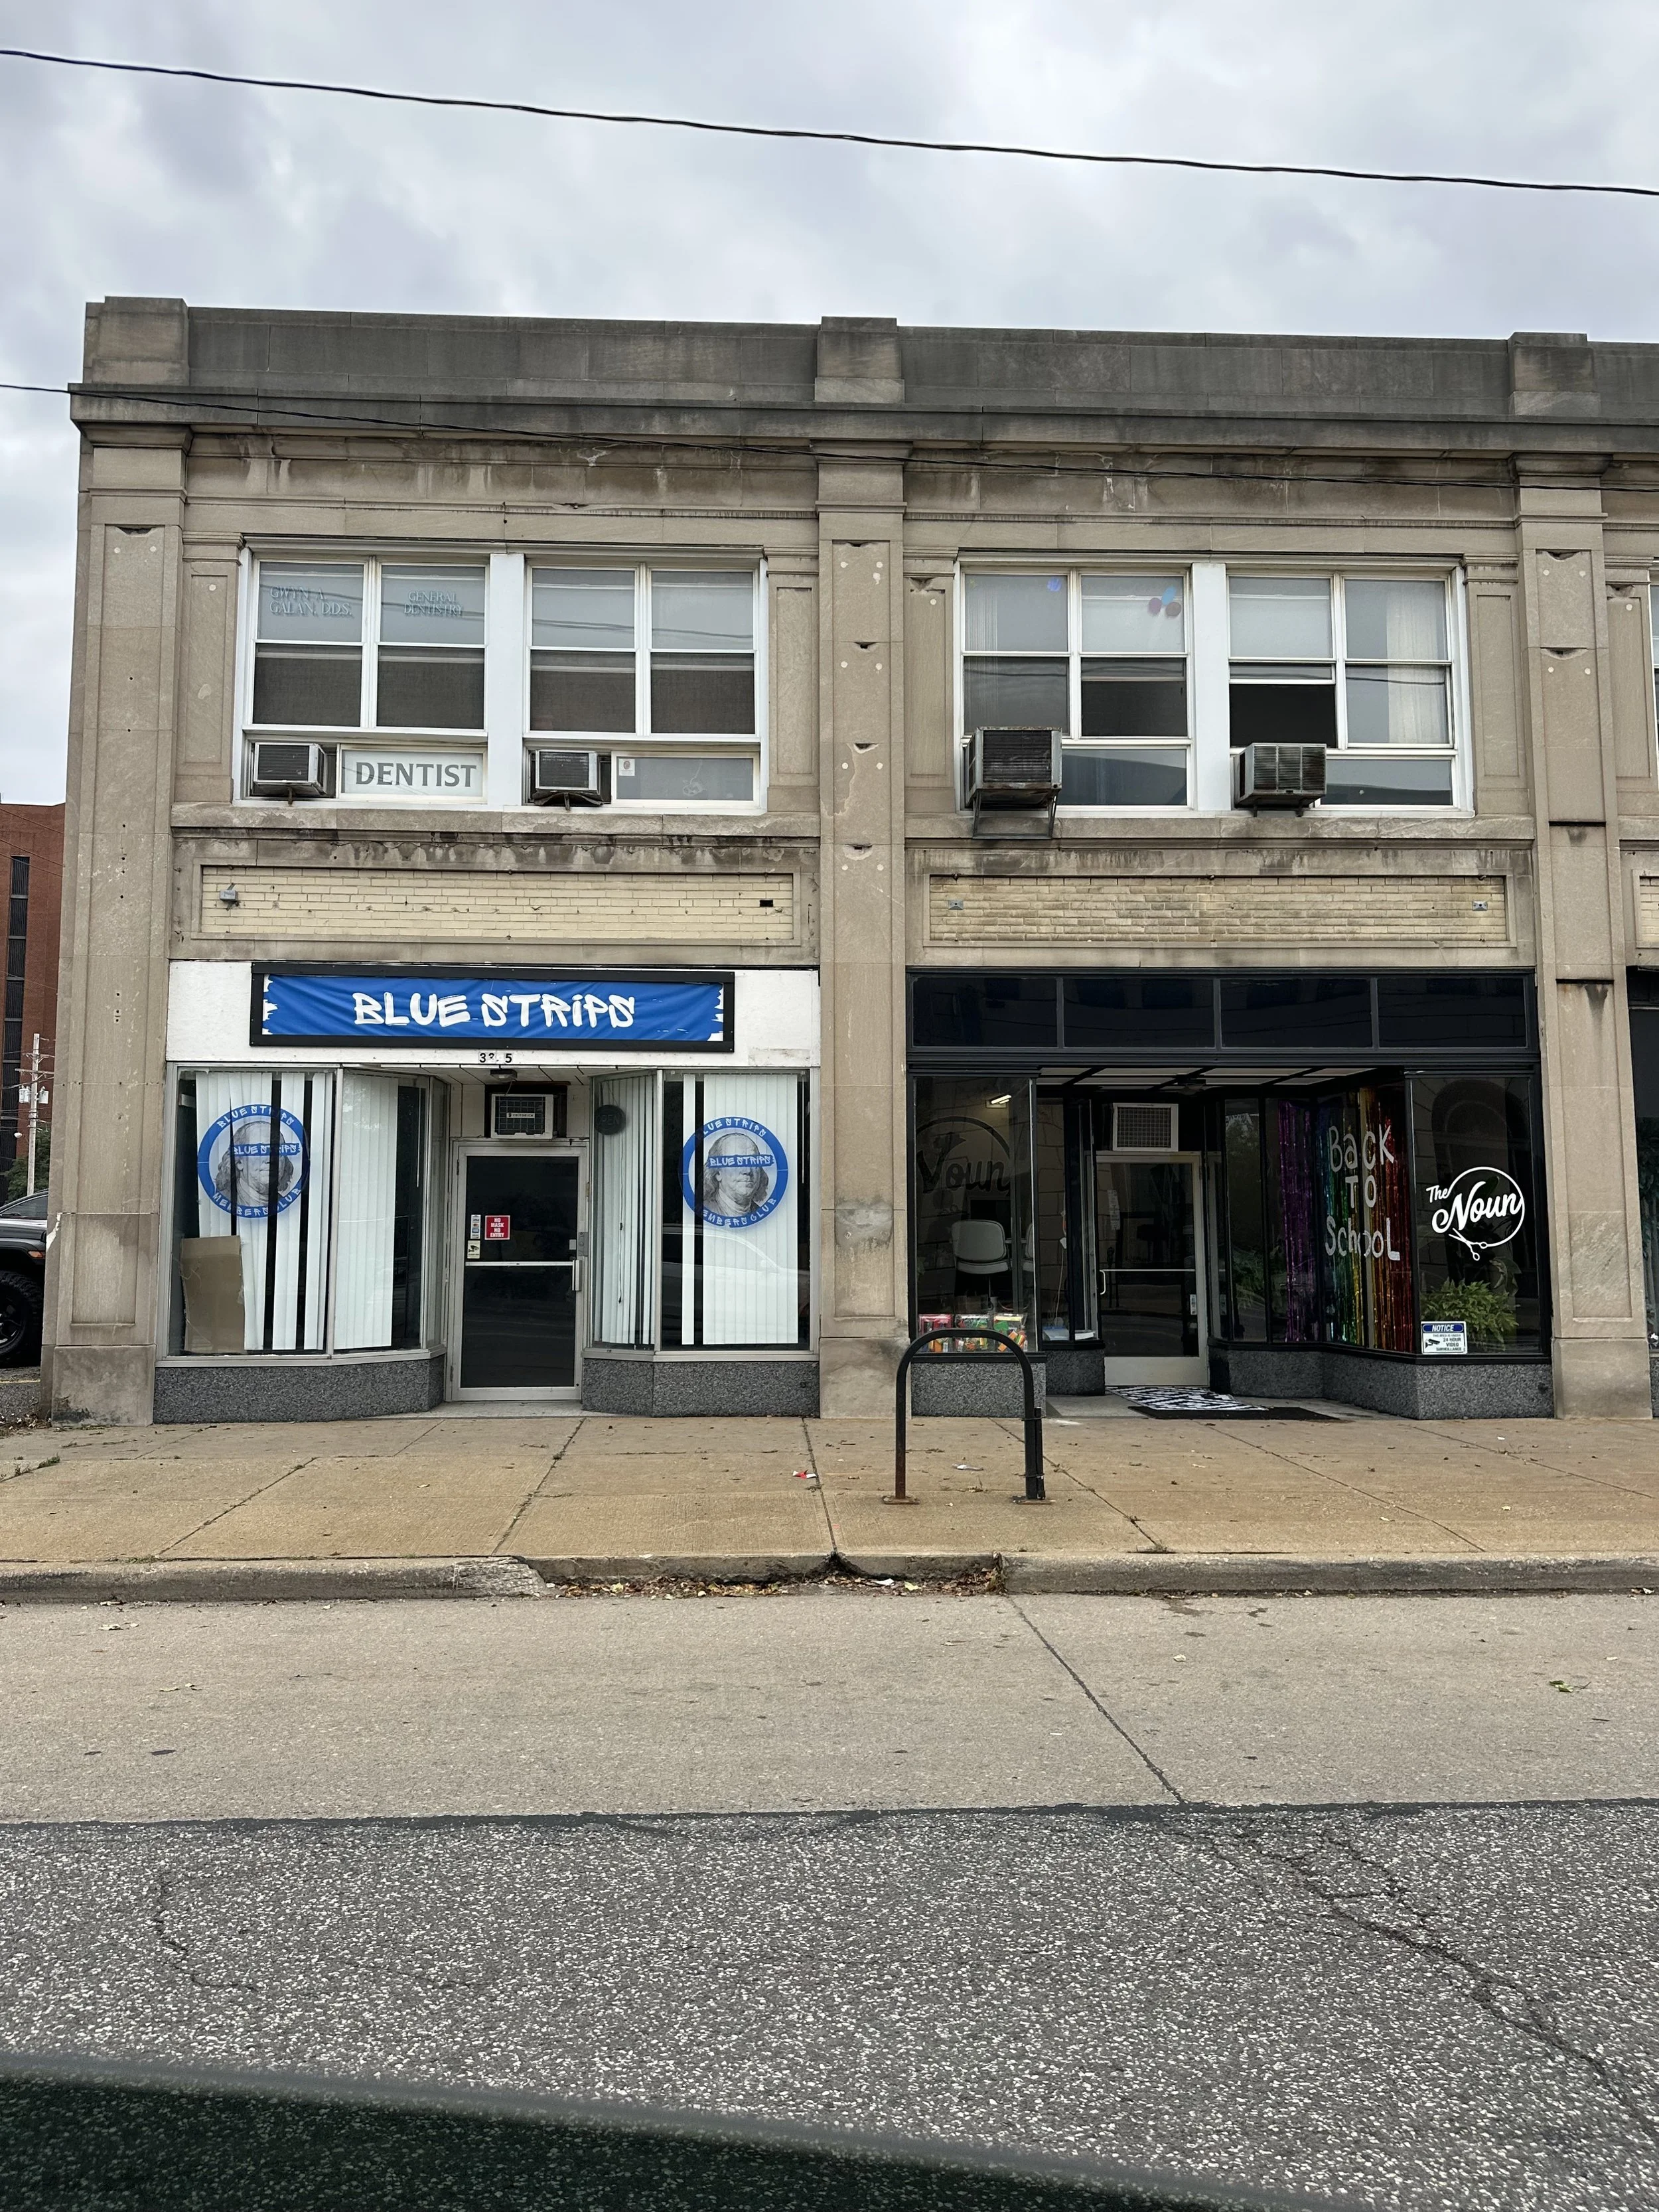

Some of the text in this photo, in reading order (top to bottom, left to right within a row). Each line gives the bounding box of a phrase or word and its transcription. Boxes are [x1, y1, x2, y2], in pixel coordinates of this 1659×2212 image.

[408, 591, 457, 602] GENERAL
[404, 603, 463, 615] DENTISTRY
[356, 762, 477, 787] DENTIST
[352, 992, 472, 1027] BLUE
[216, 1108, 248, 1128] BLUE
[709, 1157, 735, 1167] BLUE
[1345, 1175, 1377, 1208] TO
[750, 1198, 777, 1222] CLUB
[1426, 1181, 1523, 1234] The Noun
